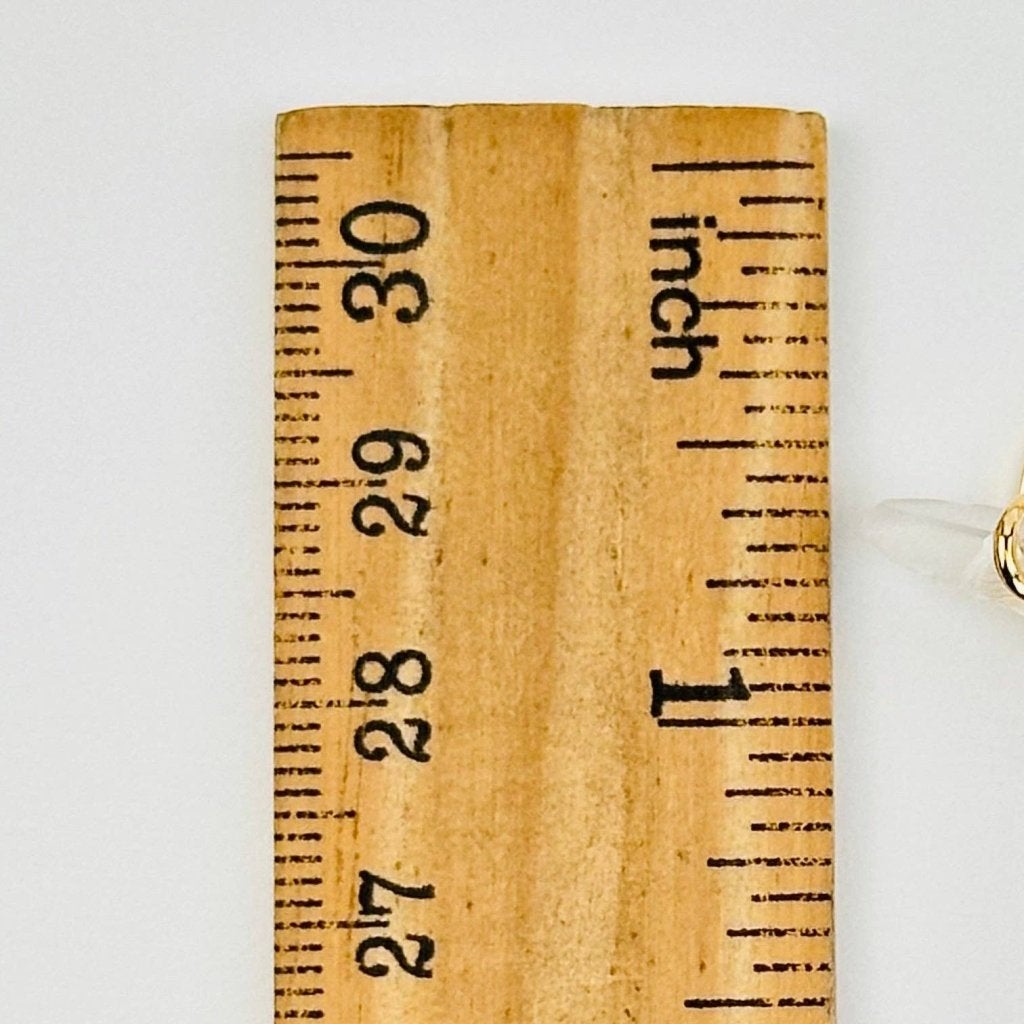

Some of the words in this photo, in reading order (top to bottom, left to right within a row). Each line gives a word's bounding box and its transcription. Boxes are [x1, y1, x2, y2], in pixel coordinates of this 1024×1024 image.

[340, 200, 431, 324] 30
[650, 213, 719, 380] inch
[351, 429, 431, 538] 29
[352, 649, 432, 763] 28
[650, 667, 751, 718] 1
[355, 870, 435, 979] 27
